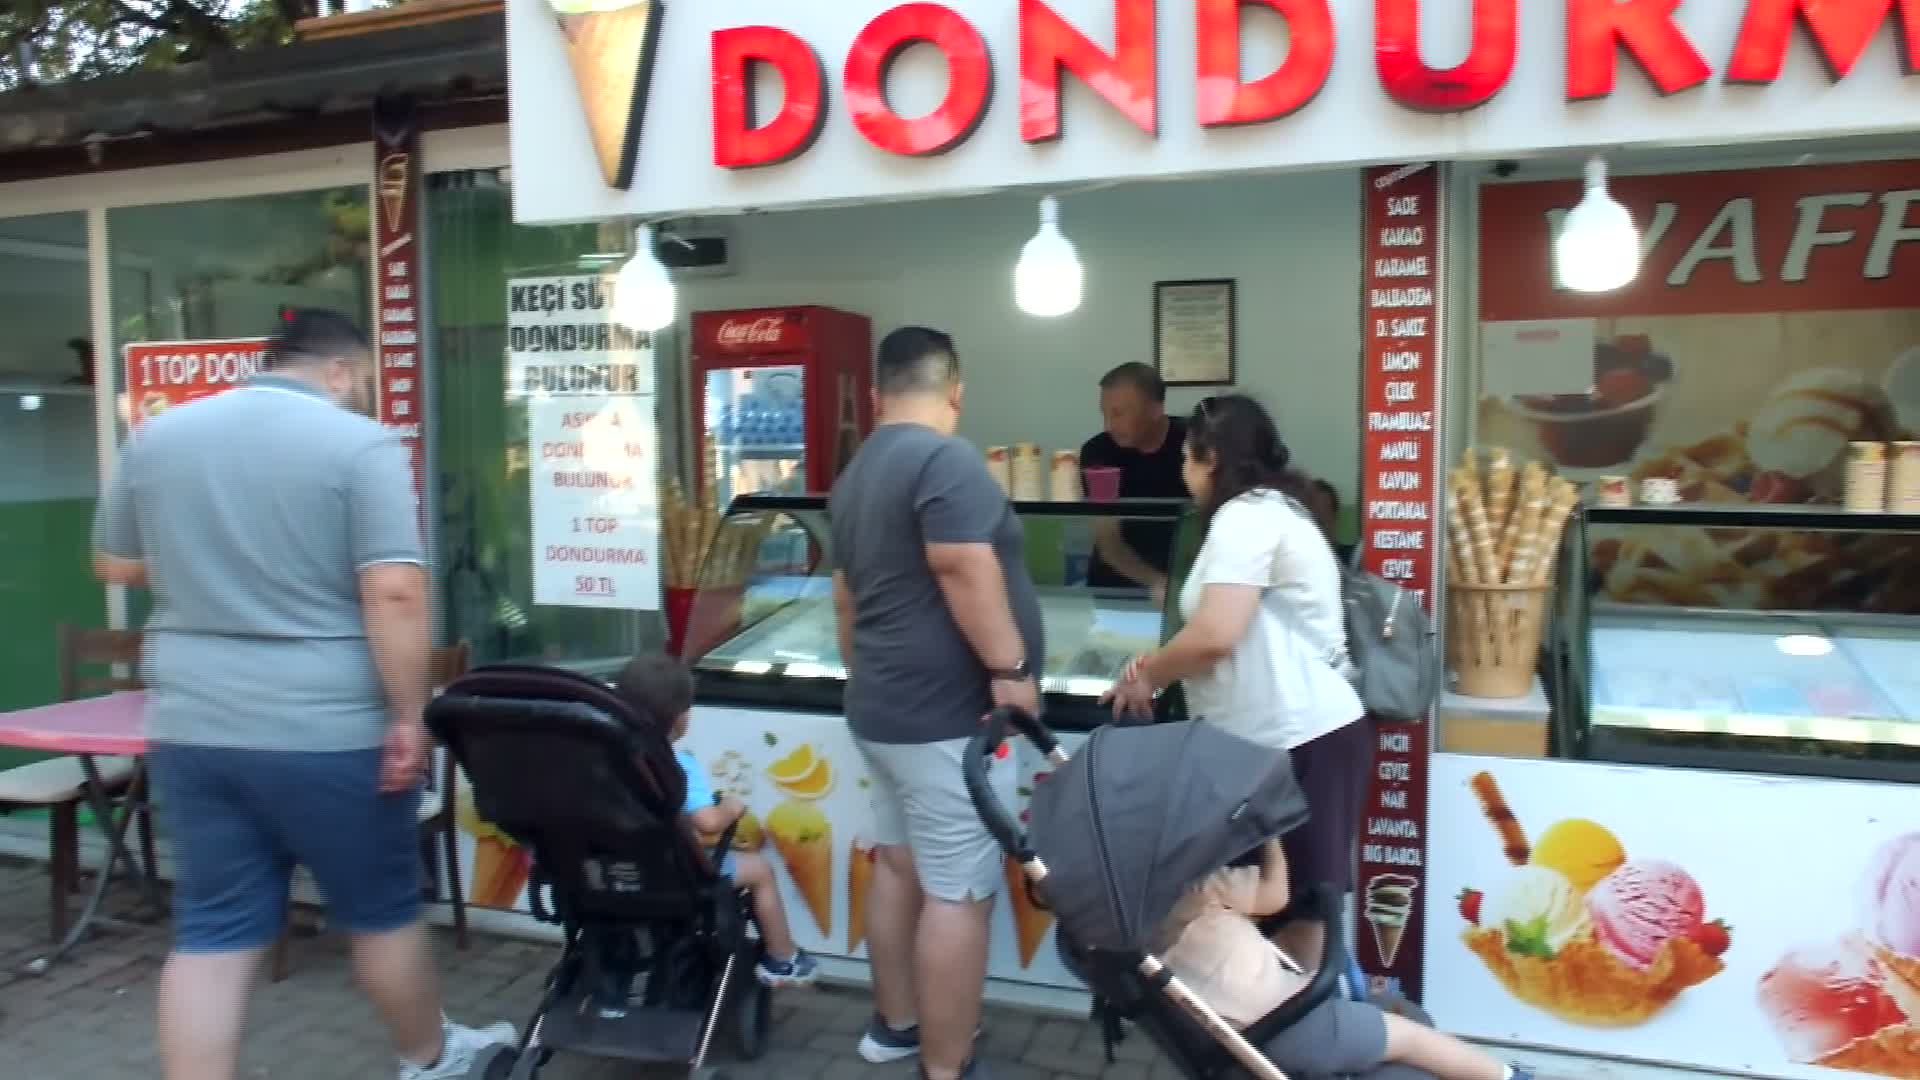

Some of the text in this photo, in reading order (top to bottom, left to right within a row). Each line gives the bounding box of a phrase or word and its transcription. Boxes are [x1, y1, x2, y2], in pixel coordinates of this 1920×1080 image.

[1387, 196, 1419, 216] SADE
[1380, 227, 1424, 246] KAKAO
[1545, 187, 1920, 291] AFF
[1375, 258, 1430, 277] KARAMEL
[511, 279, 564, 317] KEÇİ
[511, 323, 652, 352] DONDURMA
[140, 353, 153, 386] 1
[154, 353, 201, 385] TOP
[1379, 471, 1420, 490] KAVUN
[1370, 500, 1428, 520] PORTAKAL
[571, 517, 619, 534] 1 TOP
[546, 545, 647, 565] DONDURMA
[575, 576, 616, 593] 50 TL
[1368, 817, 1418, 838] LAVANTA
